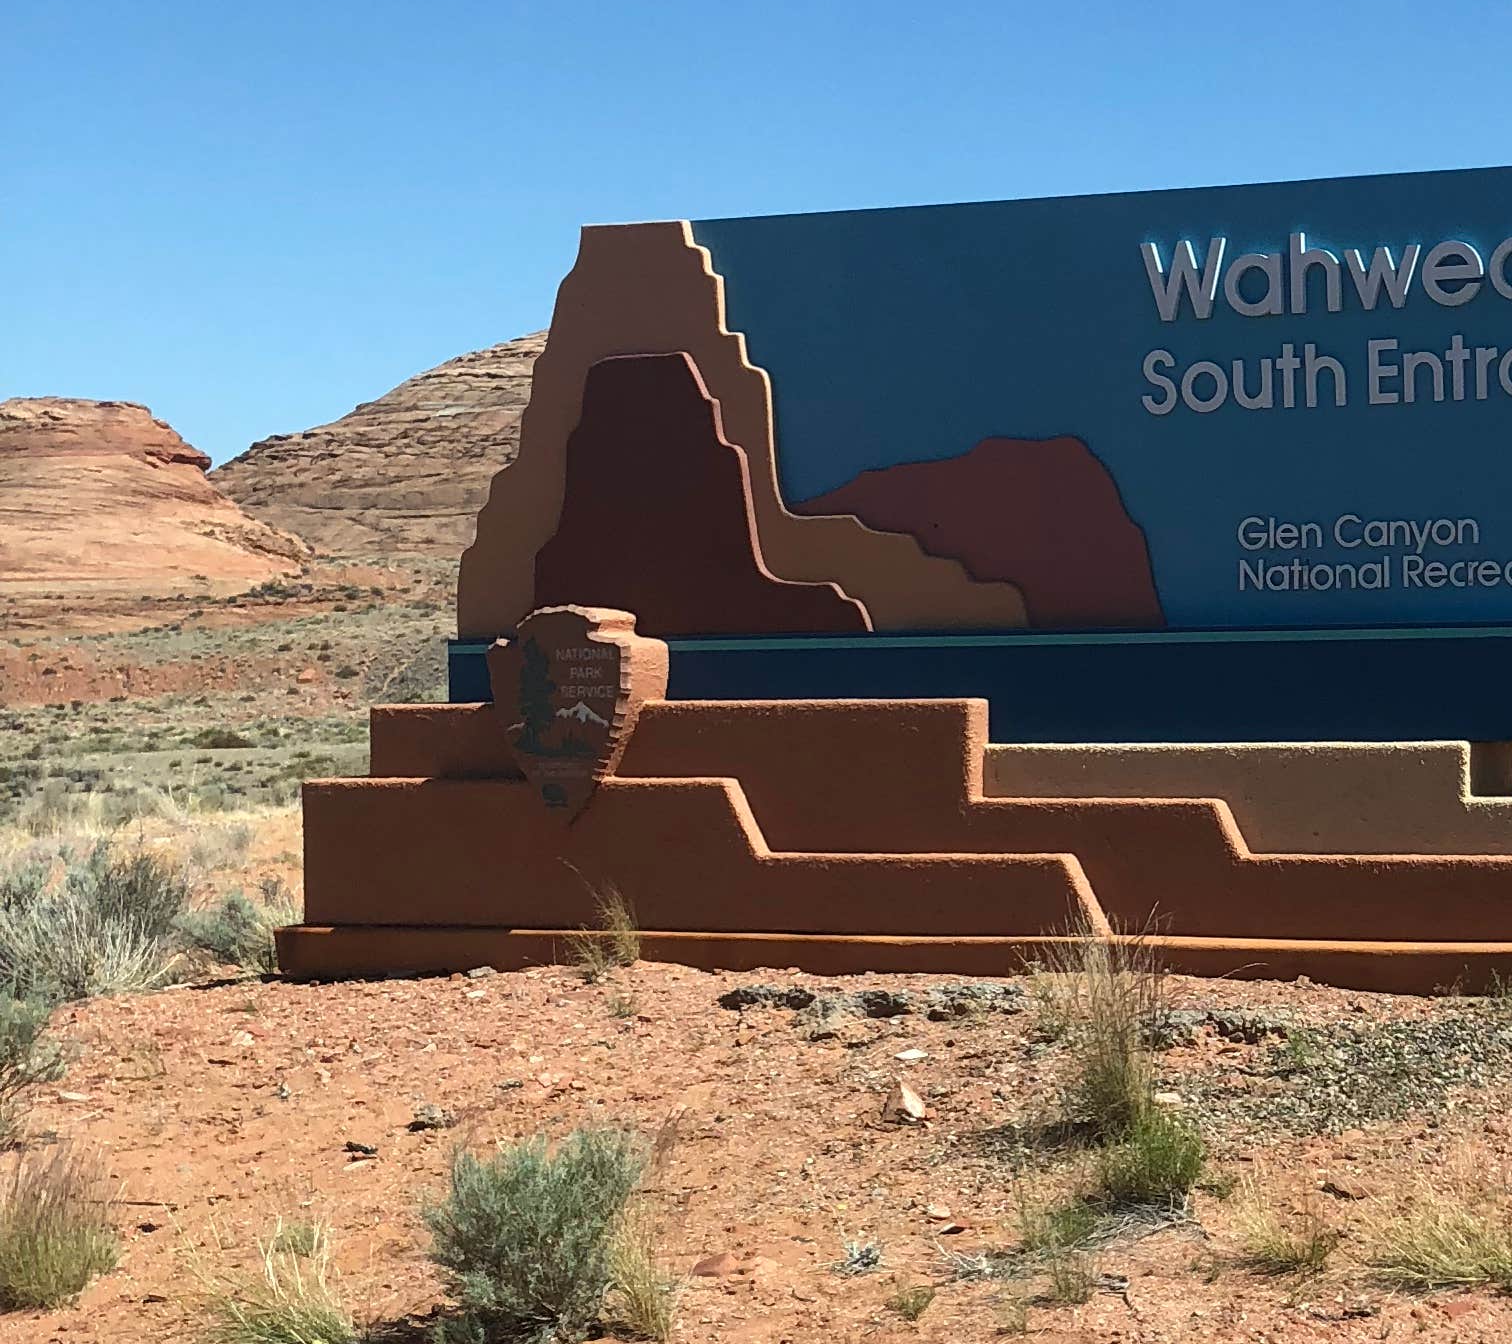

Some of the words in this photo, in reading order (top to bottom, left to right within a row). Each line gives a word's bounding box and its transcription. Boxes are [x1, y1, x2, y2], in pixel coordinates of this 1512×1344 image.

[1141, 342, 1347, 416] South
[1236, 515, 1324, 552] Glen
[1333, 513, 1480, 554] Canyon
[1238, 556, 1391, 592] National
[555, 647, 616, 661] NATIONAL
[569, 666, 603, 680] PARK
[560, 684, 615, 699] SERVICE
